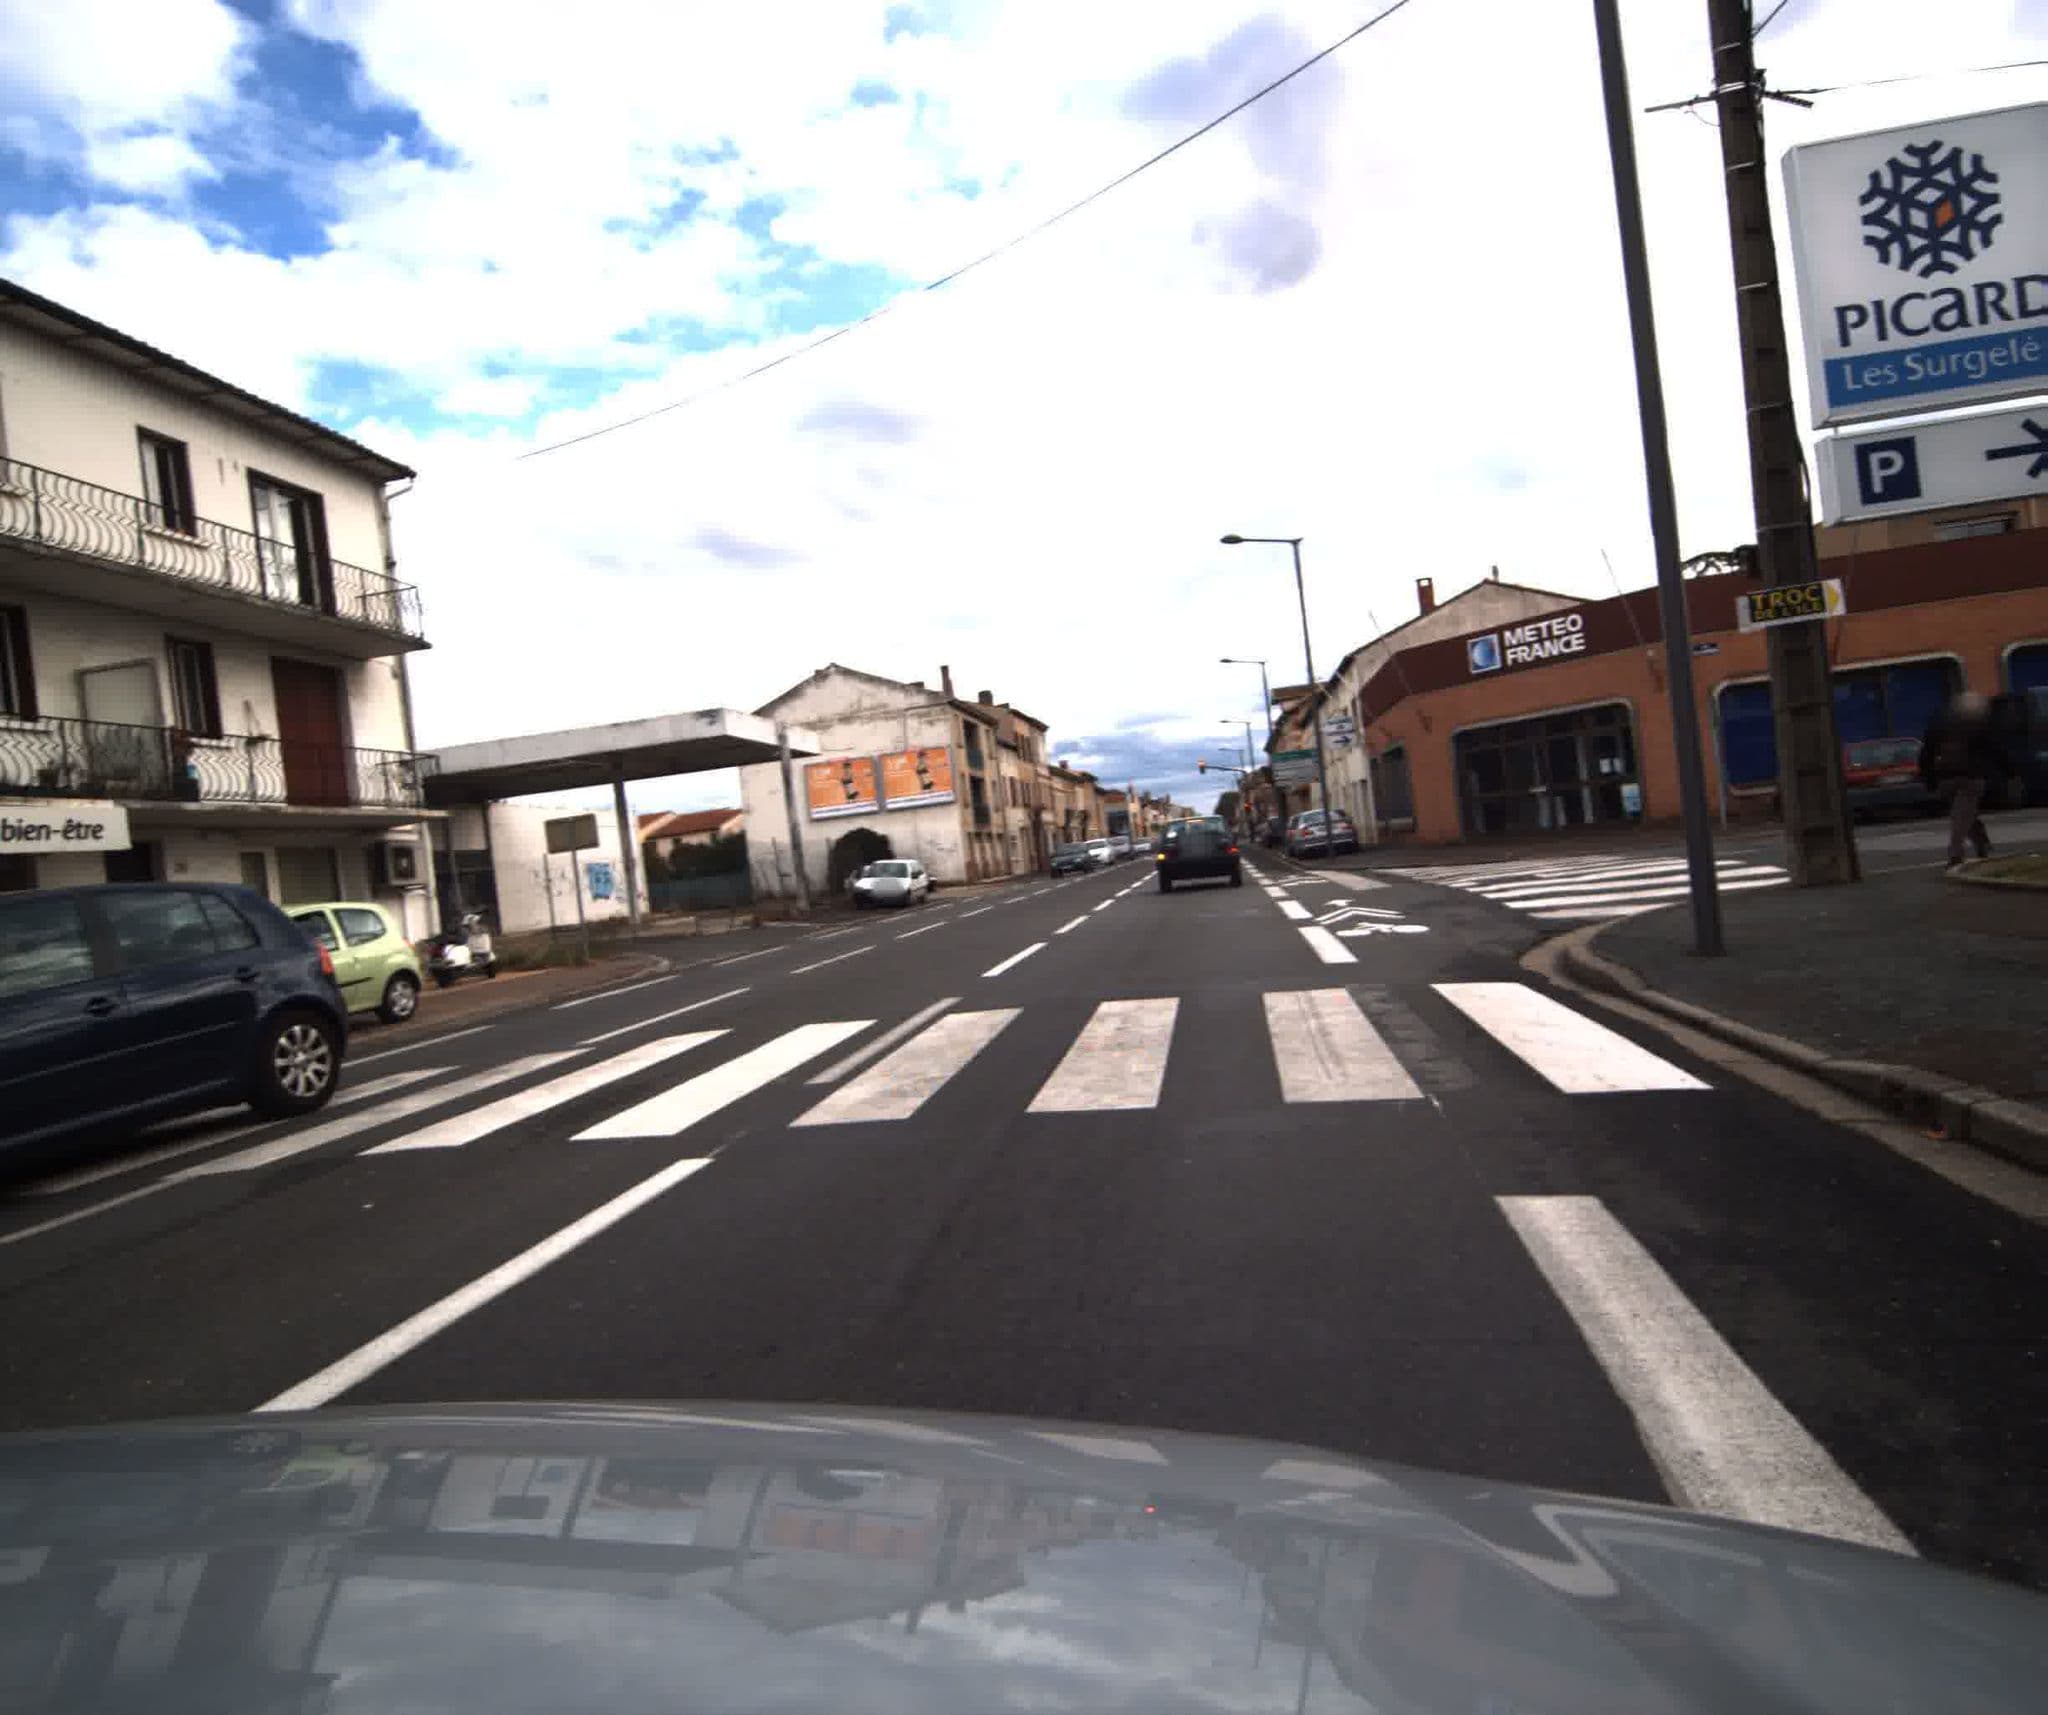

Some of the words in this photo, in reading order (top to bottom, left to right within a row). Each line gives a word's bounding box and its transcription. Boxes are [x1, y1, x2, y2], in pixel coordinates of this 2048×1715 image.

[1842, 362, 1898, 391] Les
[1867, 449, 1905, 495] P
[1752, 584, 1820, 611] TROC
[1503, 613, 1583, 647] METEO
[1506, 632, 1586, 666] FRANCE
[0, 818, 104, 842] bien-être
